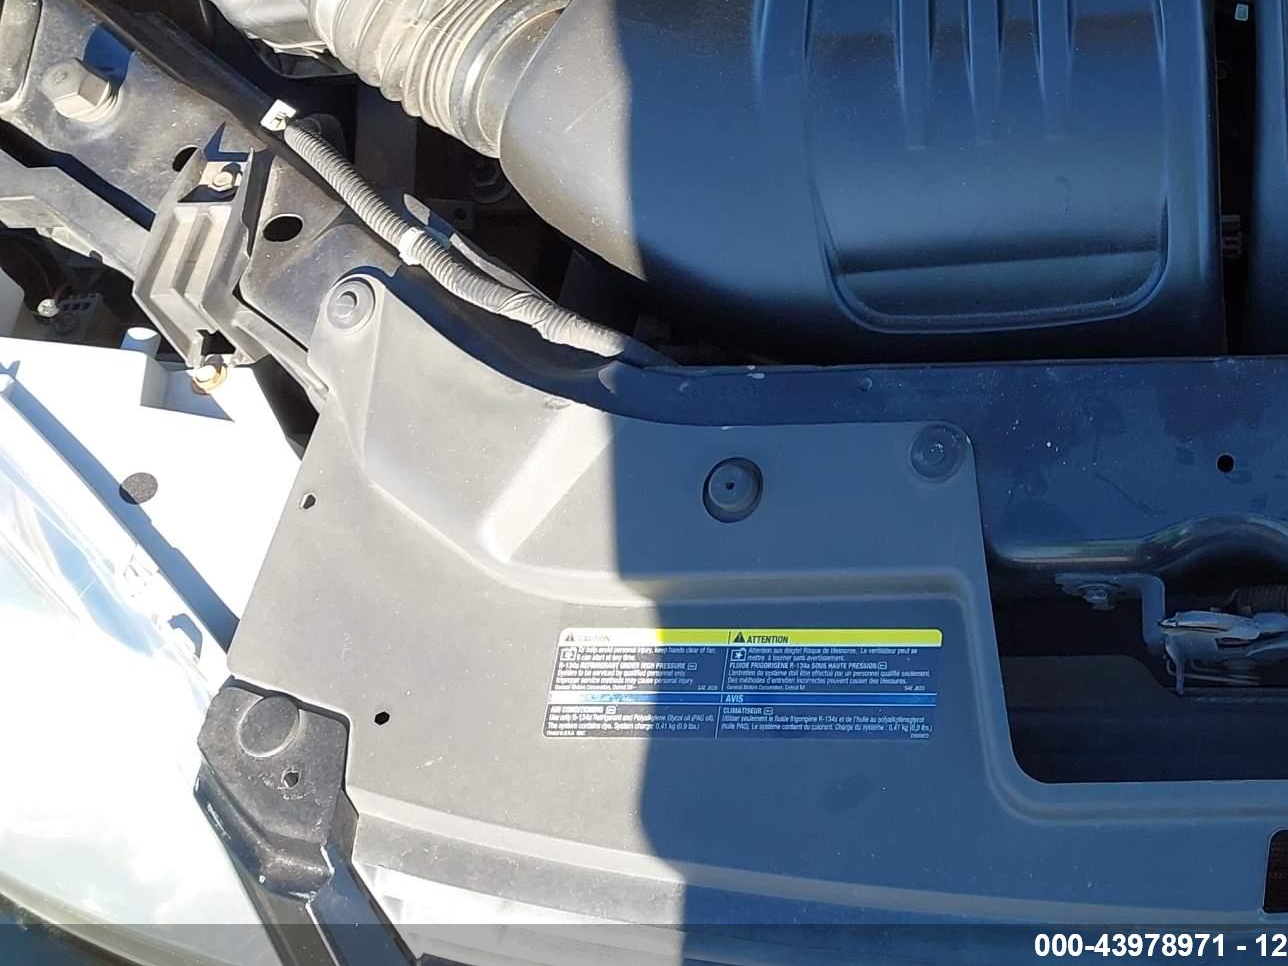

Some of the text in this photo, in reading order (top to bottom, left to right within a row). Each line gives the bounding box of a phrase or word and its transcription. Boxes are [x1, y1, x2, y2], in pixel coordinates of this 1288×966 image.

[746, 634, 790, 644] ATTENTION
[656, 662, 686, 670] PRESSURE
[725, 694, 745, 703] AVIS
[723, 707, 764, 715] CLIMATISEUR
